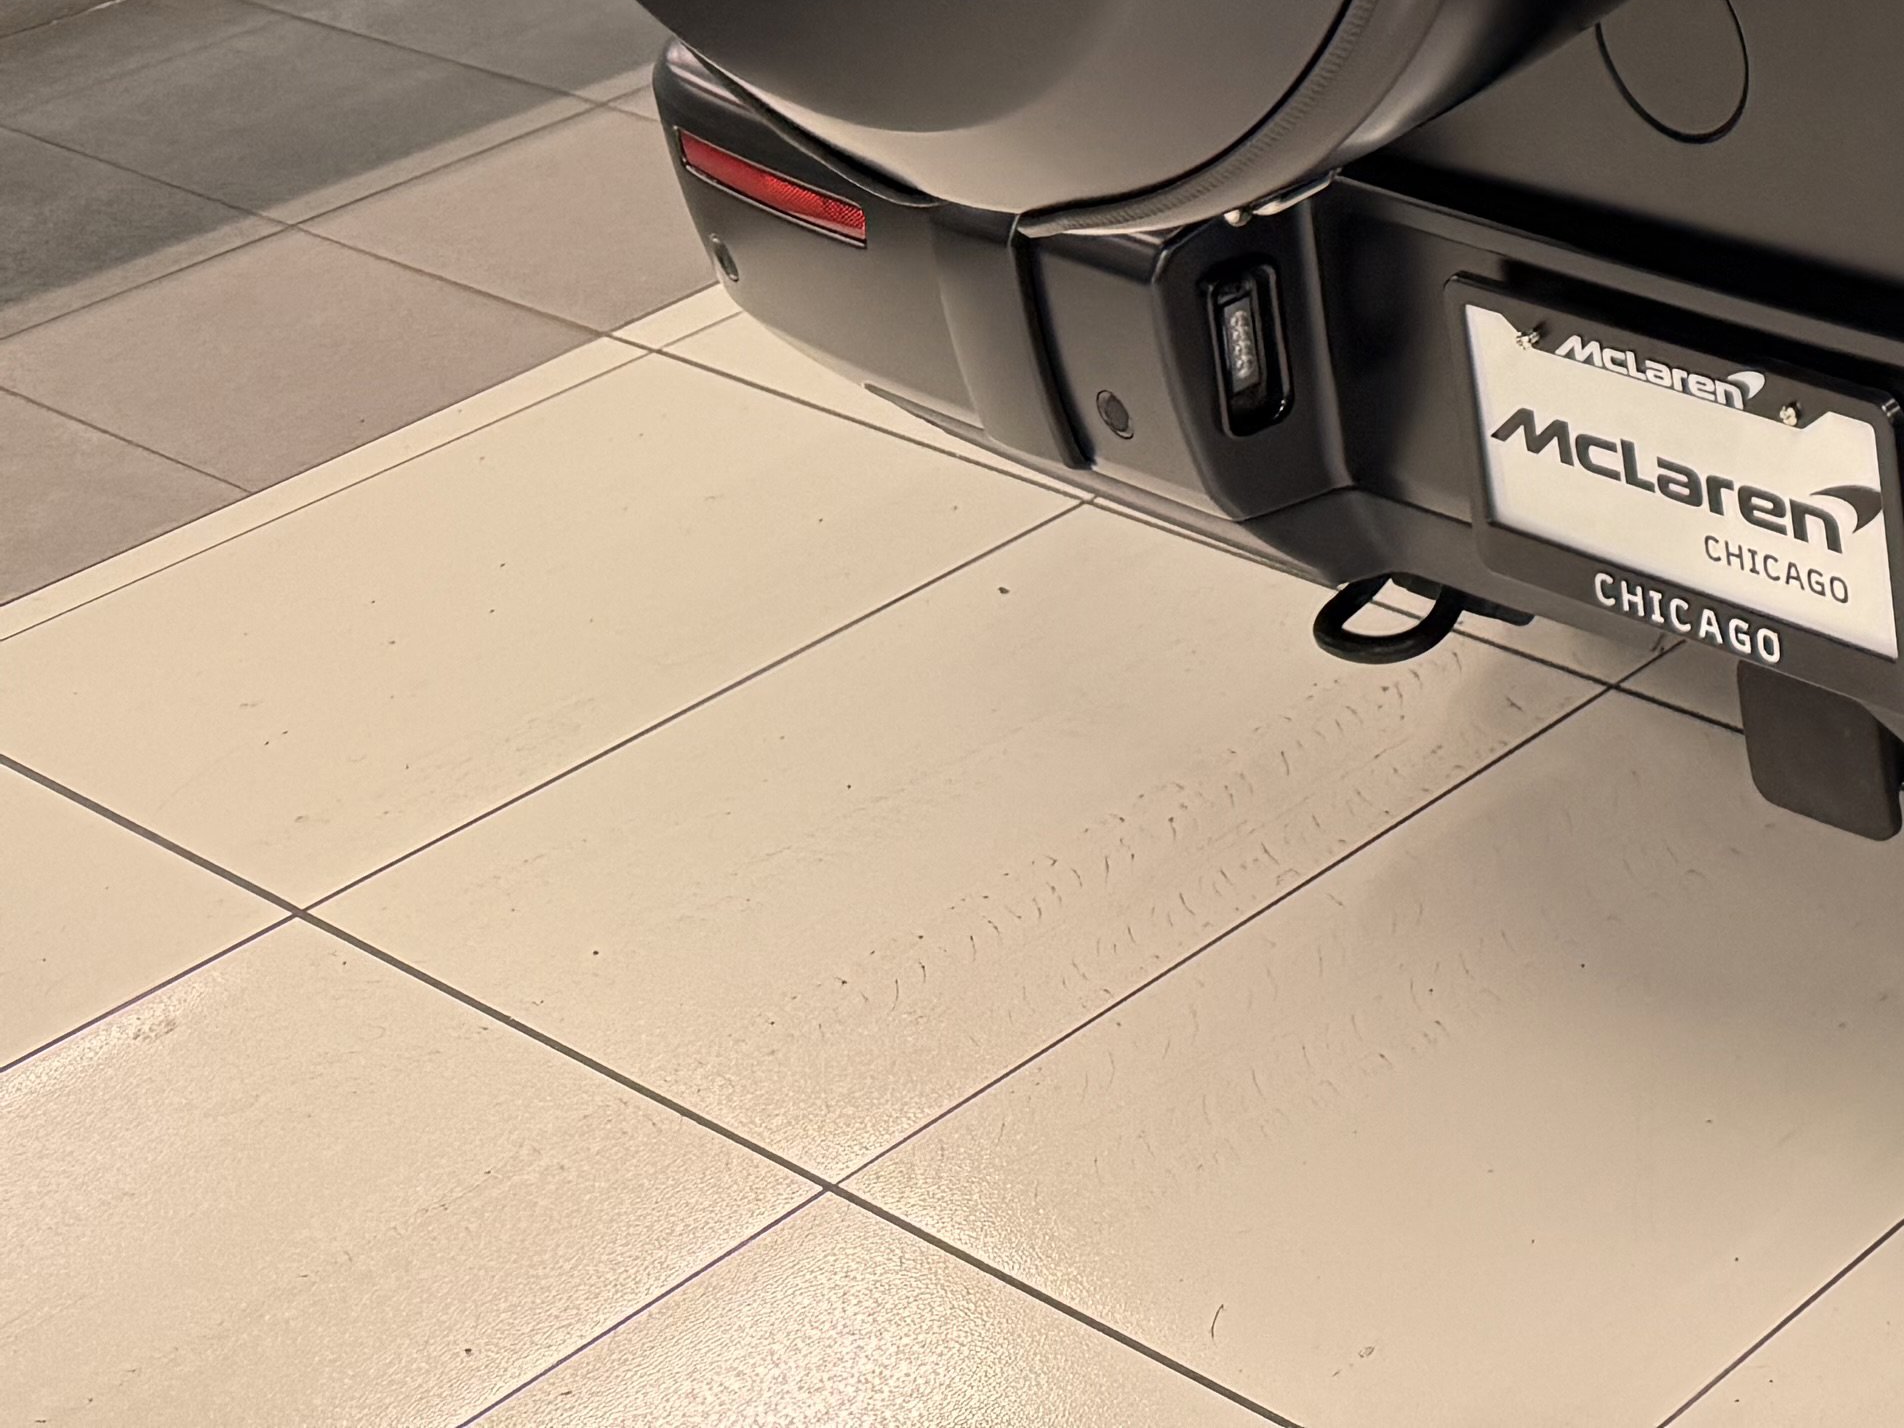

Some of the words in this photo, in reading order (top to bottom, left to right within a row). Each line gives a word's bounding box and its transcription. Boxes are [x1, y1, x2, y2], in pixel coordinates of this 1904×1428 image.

[1554, 334, 1746, 411] McLaren
[1490, 407, 1845, 555] McLaren
[1703, 534, 1850, 605] CHICAGO
[1594, 571, 1782, 665] CHICAGO
